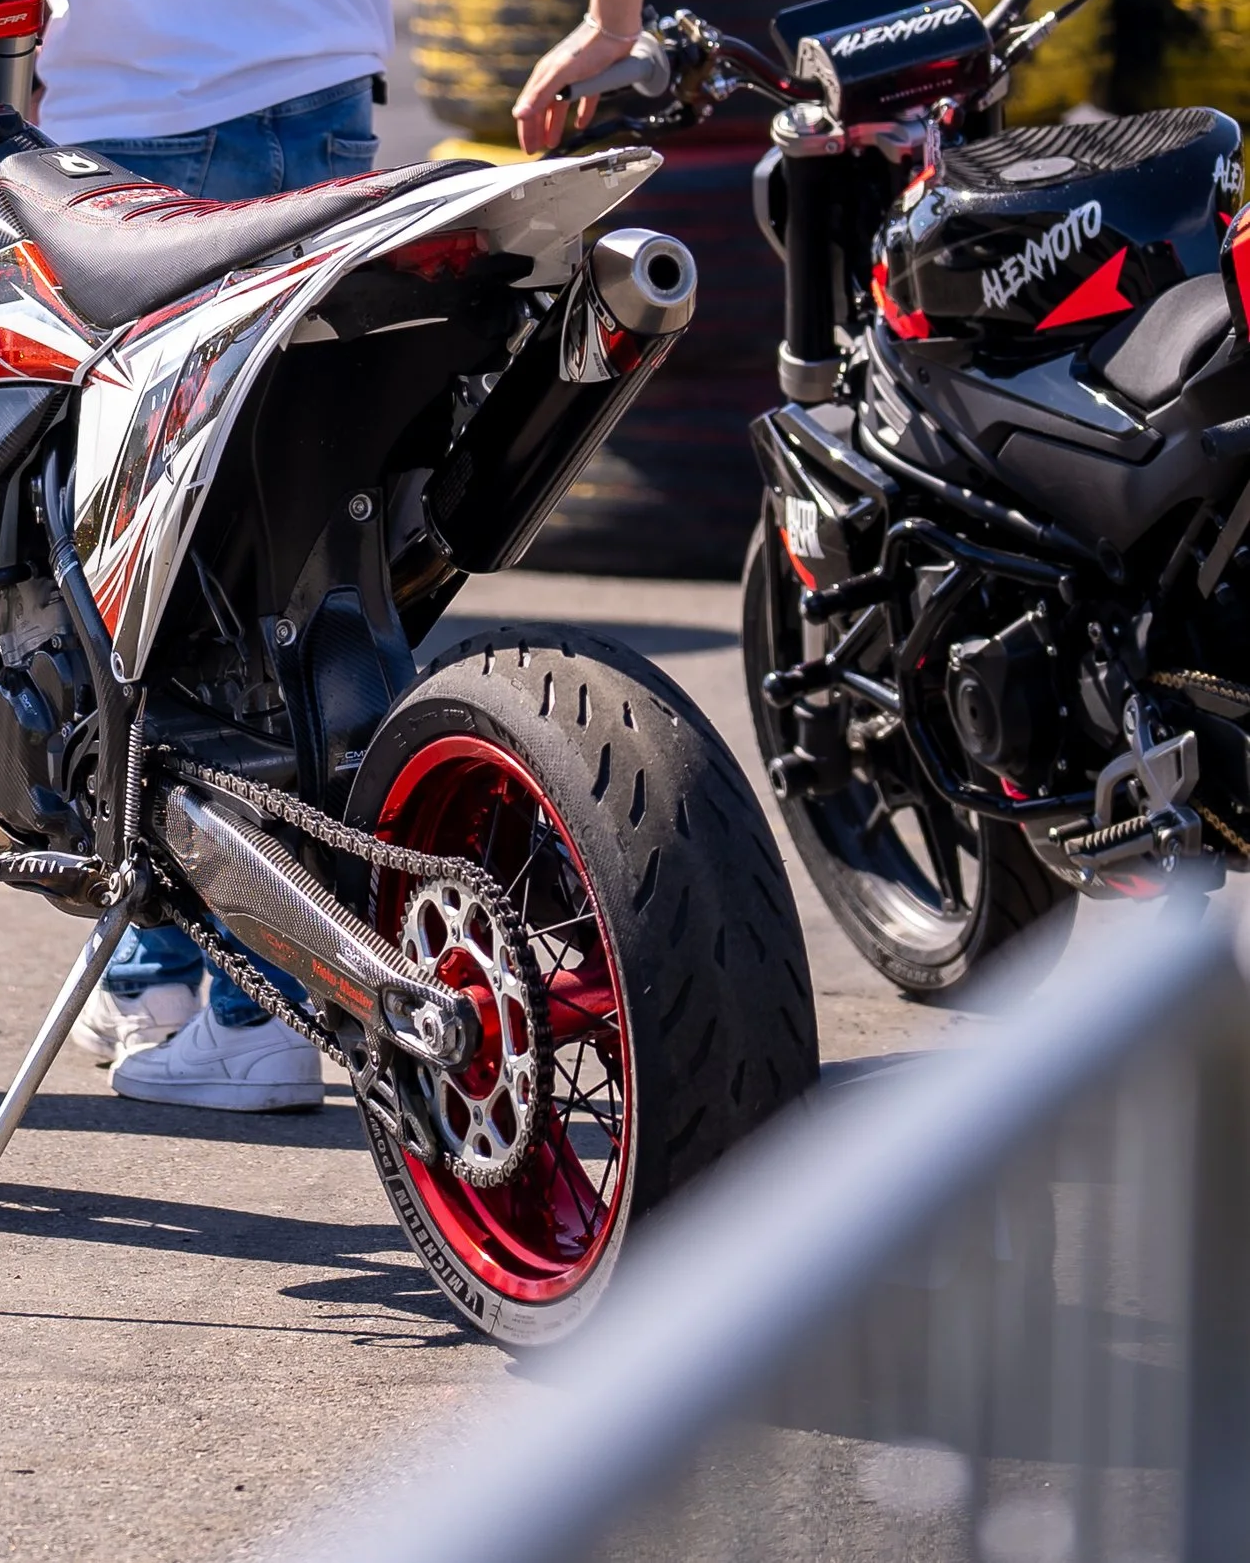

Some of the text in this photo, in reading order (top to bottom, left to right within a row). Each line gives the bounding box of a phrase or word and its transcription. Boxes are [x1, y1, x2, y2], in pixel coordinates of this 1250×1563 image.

[831, 4, 964, 58] ALEXMOTO
[981, 199, 1102, 310] ALEXMOTO
[394, 1188, 466, 1293] MICHELIN
